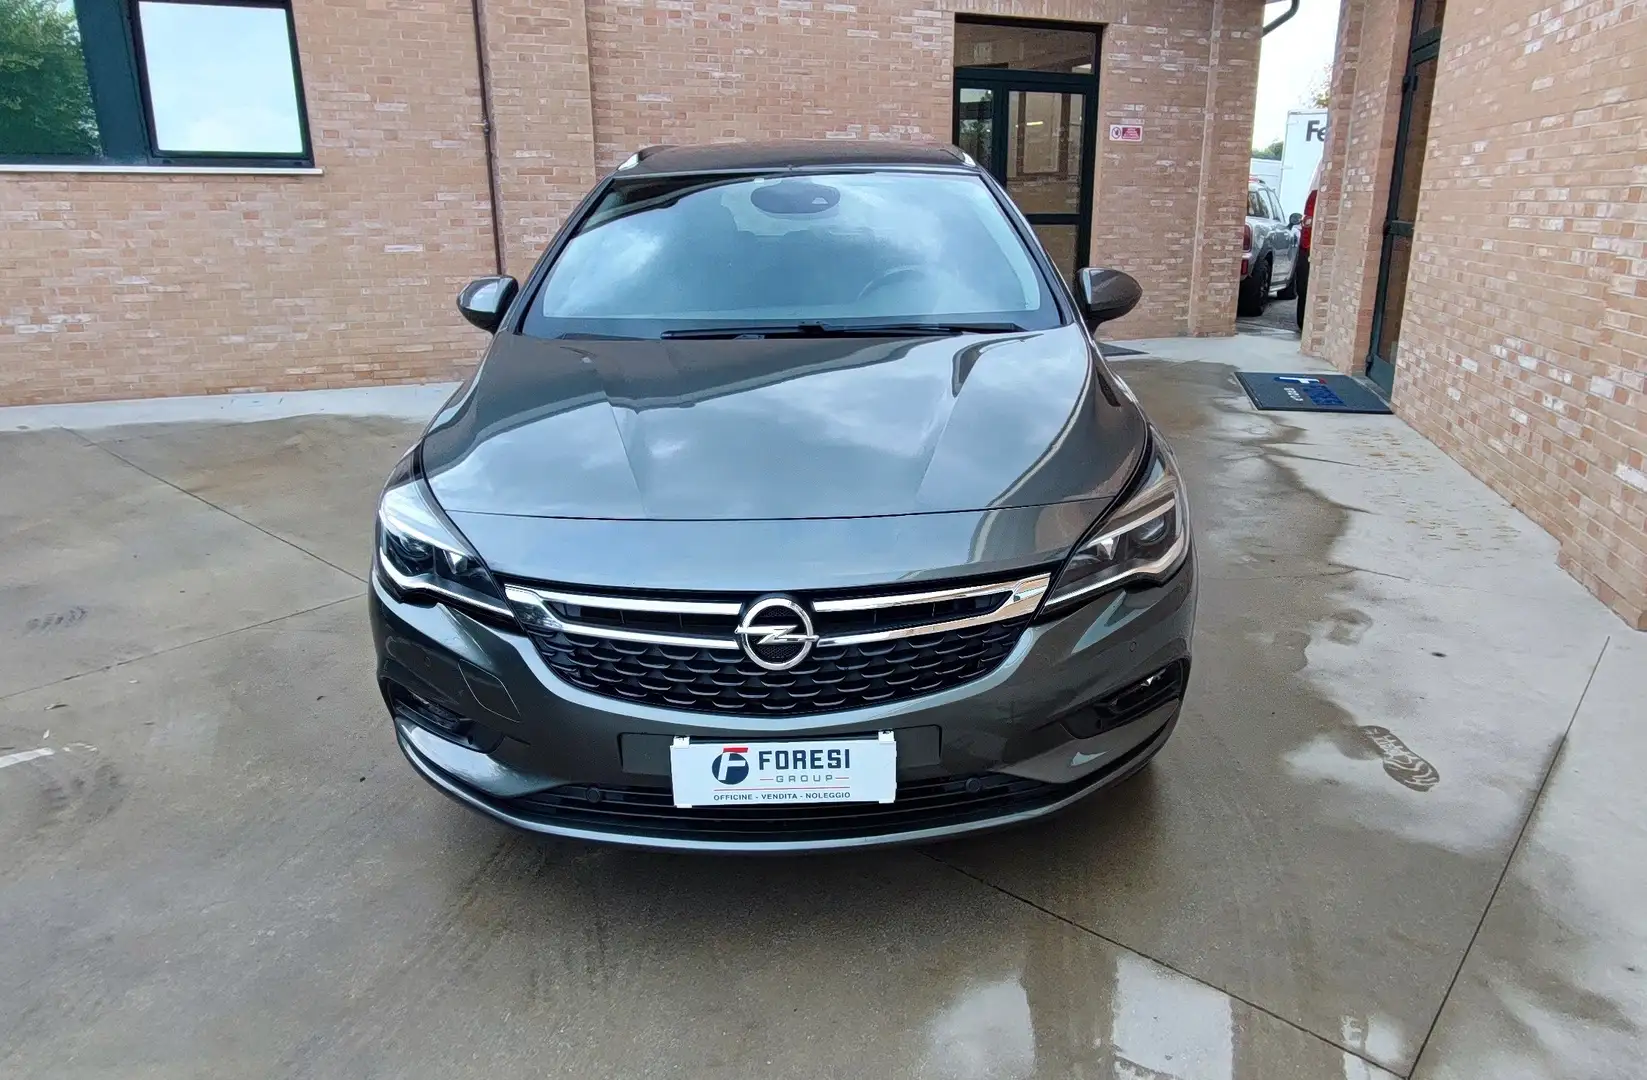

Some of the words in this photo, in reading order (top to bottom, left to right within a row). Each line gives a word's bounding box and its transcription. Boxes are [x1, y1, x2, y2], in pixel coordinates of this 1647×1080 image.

[758, 748, 850, 771] FORESI
[776, 774, 833, 783] GROUP
[713, 793, 753, 801] OFFICINE
[761, 792, 798, 800] VENDITA
[805, 791, 851, 799] NOLEGGIO
